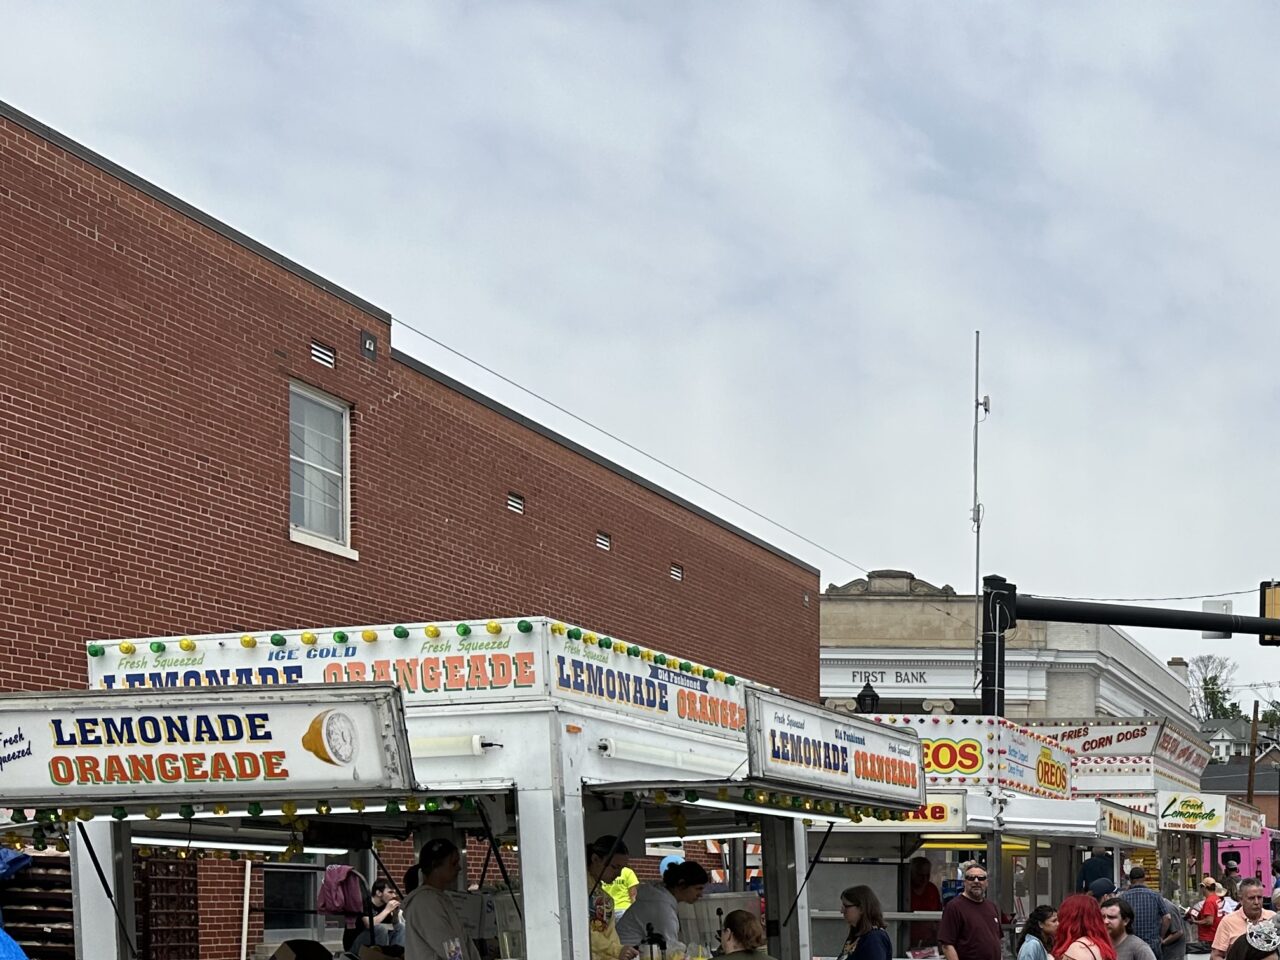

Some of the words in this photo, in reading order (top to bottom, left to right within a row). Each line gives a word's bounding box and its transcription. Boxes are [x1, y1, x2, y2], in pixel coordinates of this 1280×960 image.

[267, 648, 299, 661] ICE
[306, 646, 357, 659] COLD
[421, 639, 450, 653] Fresh
[457, 636, 511, 652] Squeezed
[564, 641, 581, 655] Fresh
[583, 648, 609, 664] Squeezed
[118, 655, 147, 670] Fresh
[152, 652, 205, 669] Squeezed
[323, 652, 536, 693] ORANGEADE
[556, 655, 669, 713] LEMONADE
[658, 669, 669, 681] Old
[669, 671, 701, 690] Fashioned
[852, 671, 886, 683] FIRST
[895, 671, 927, 683] BANK
[49, 713, 273, 748] LEMONADE
[774, 711, 785, 725] Fresh
[787, 715, 805, 730] Squeezed
[843, 730, 866, 746] Fashioned
[1061, 726, 1089, 742] FRIES
[1082, 735, 1113, 752] CORN
[1116, 726, 1148, 743] DOGS
[0, 740, 32, 771] queezed
[770, 729, 849, 775] LEMONADE
[854, 750, 917, 789] ORANGEADE
[49, 751, 289, 785] ORANGEADE
[1037, 758, 1067, 790] OREOS
[1161, 797, 1215, 820] Lemonade
[1180, 799, 1204, 810] Fresh
